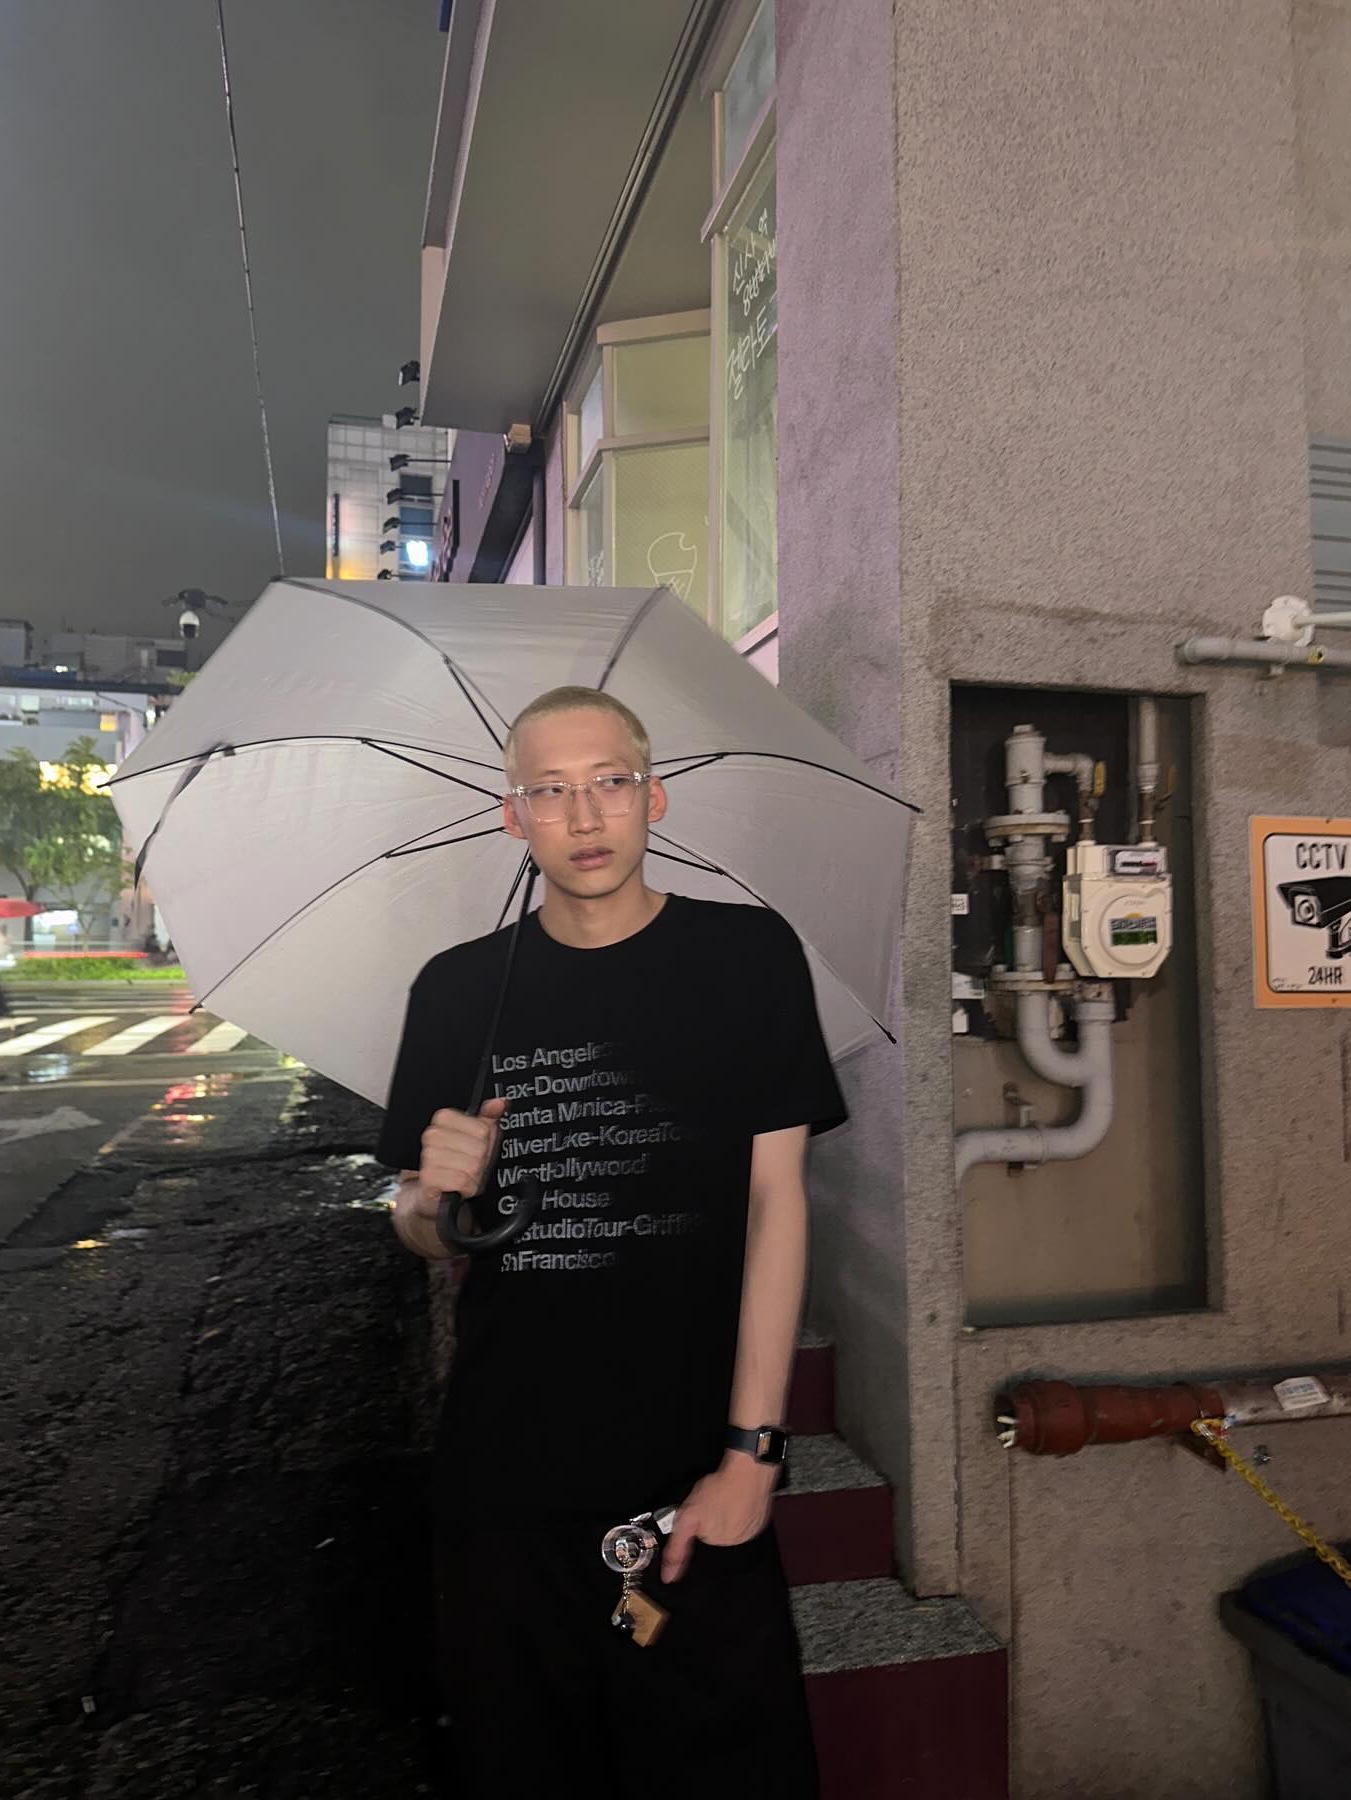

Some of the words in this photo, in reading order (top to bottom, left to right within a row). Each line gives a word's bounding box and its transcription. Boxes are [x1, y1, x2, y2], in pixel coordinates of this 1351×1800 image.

[1295, 842, 1348, 870] CCTV
[1307, 966, 1344, 985] 24HR
[491, 1053, 527, 1074] Los
[500, 1107, 554, 1131] Santa
[541, 1189, 613, 1210] House
